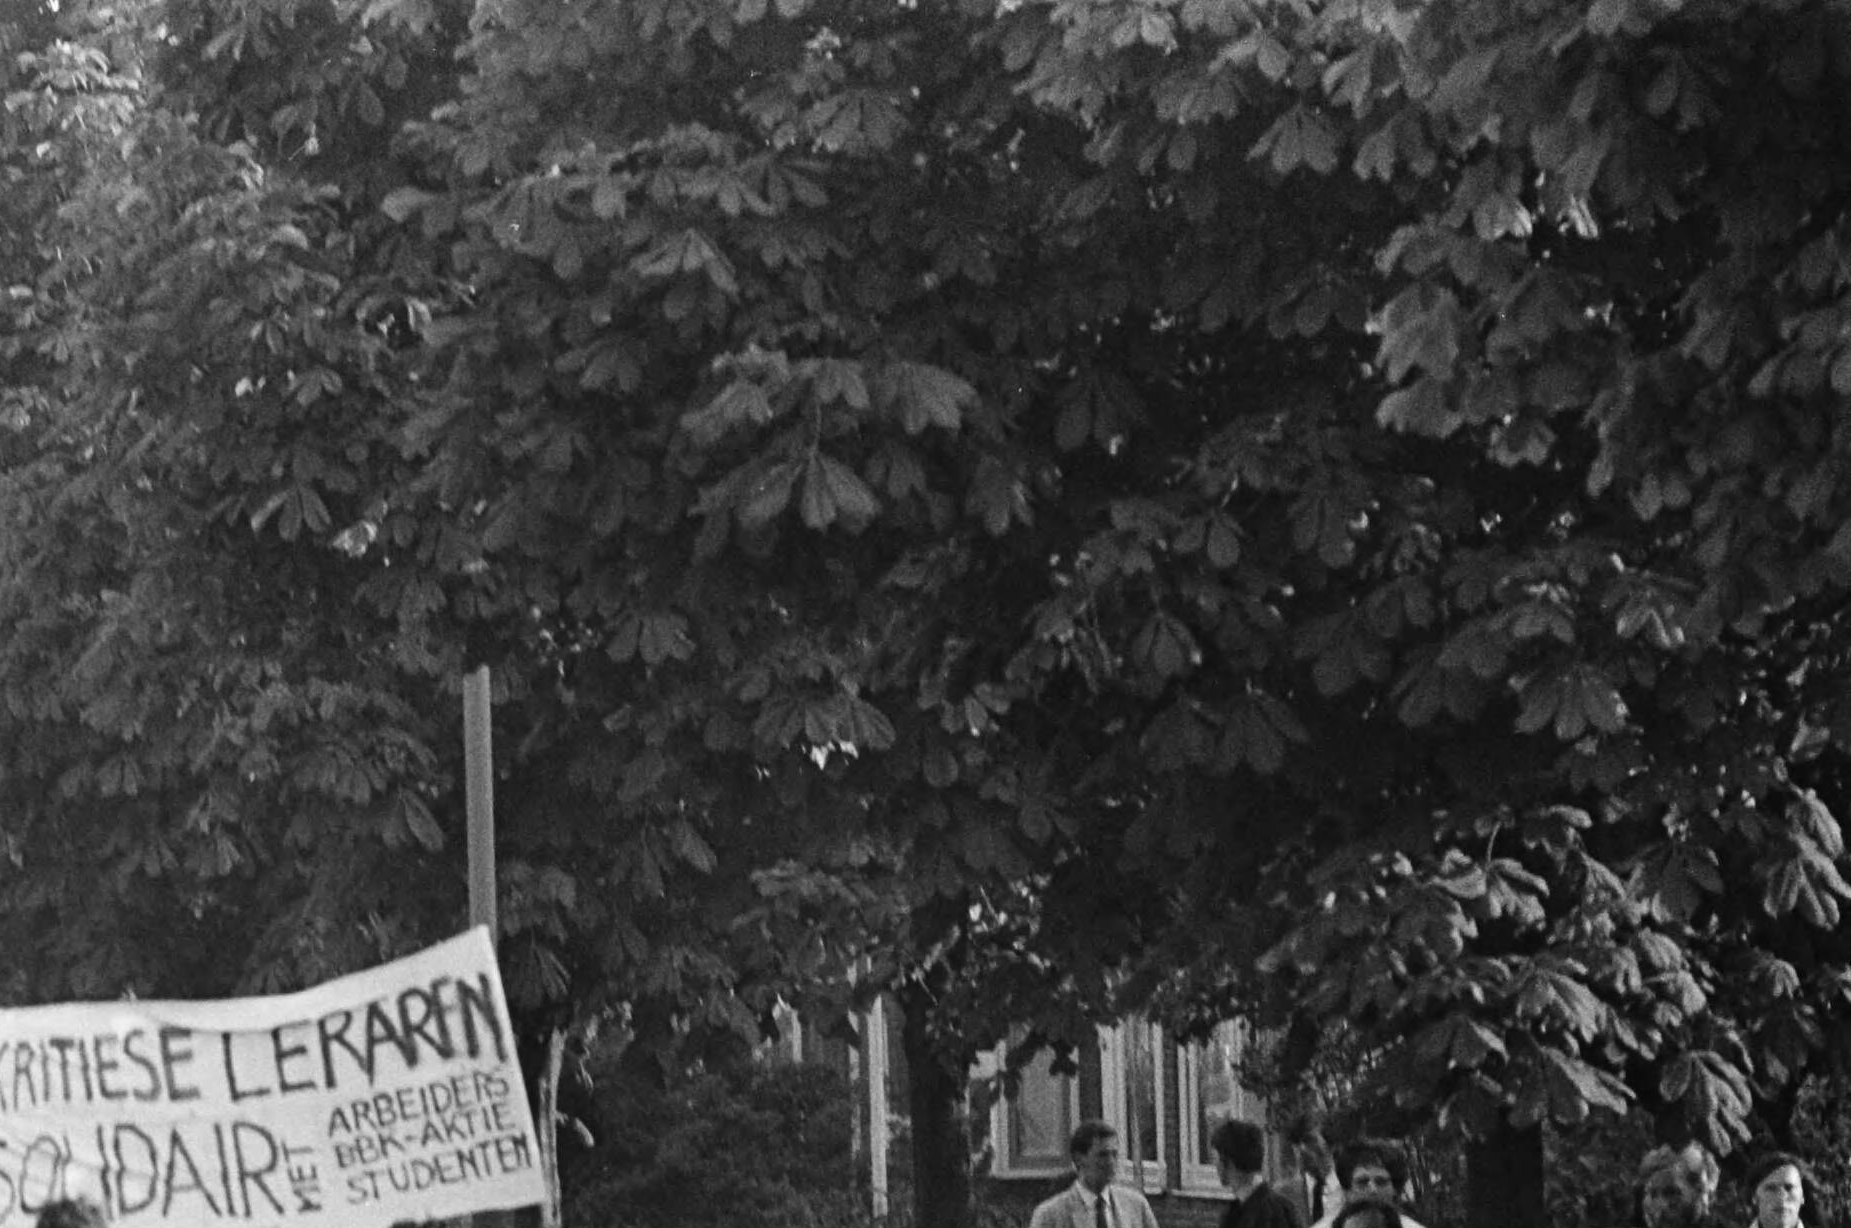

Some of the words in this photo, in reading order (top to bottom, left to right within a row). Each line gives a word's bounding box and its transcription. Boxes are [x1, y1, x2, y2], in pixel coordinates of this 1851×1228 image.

[221, 972, 508, 1103] LERAREN
[327, 1071, 510, 1139] ARBEIDERS
[347, 1131, 532, 1204] STUDENTEN
